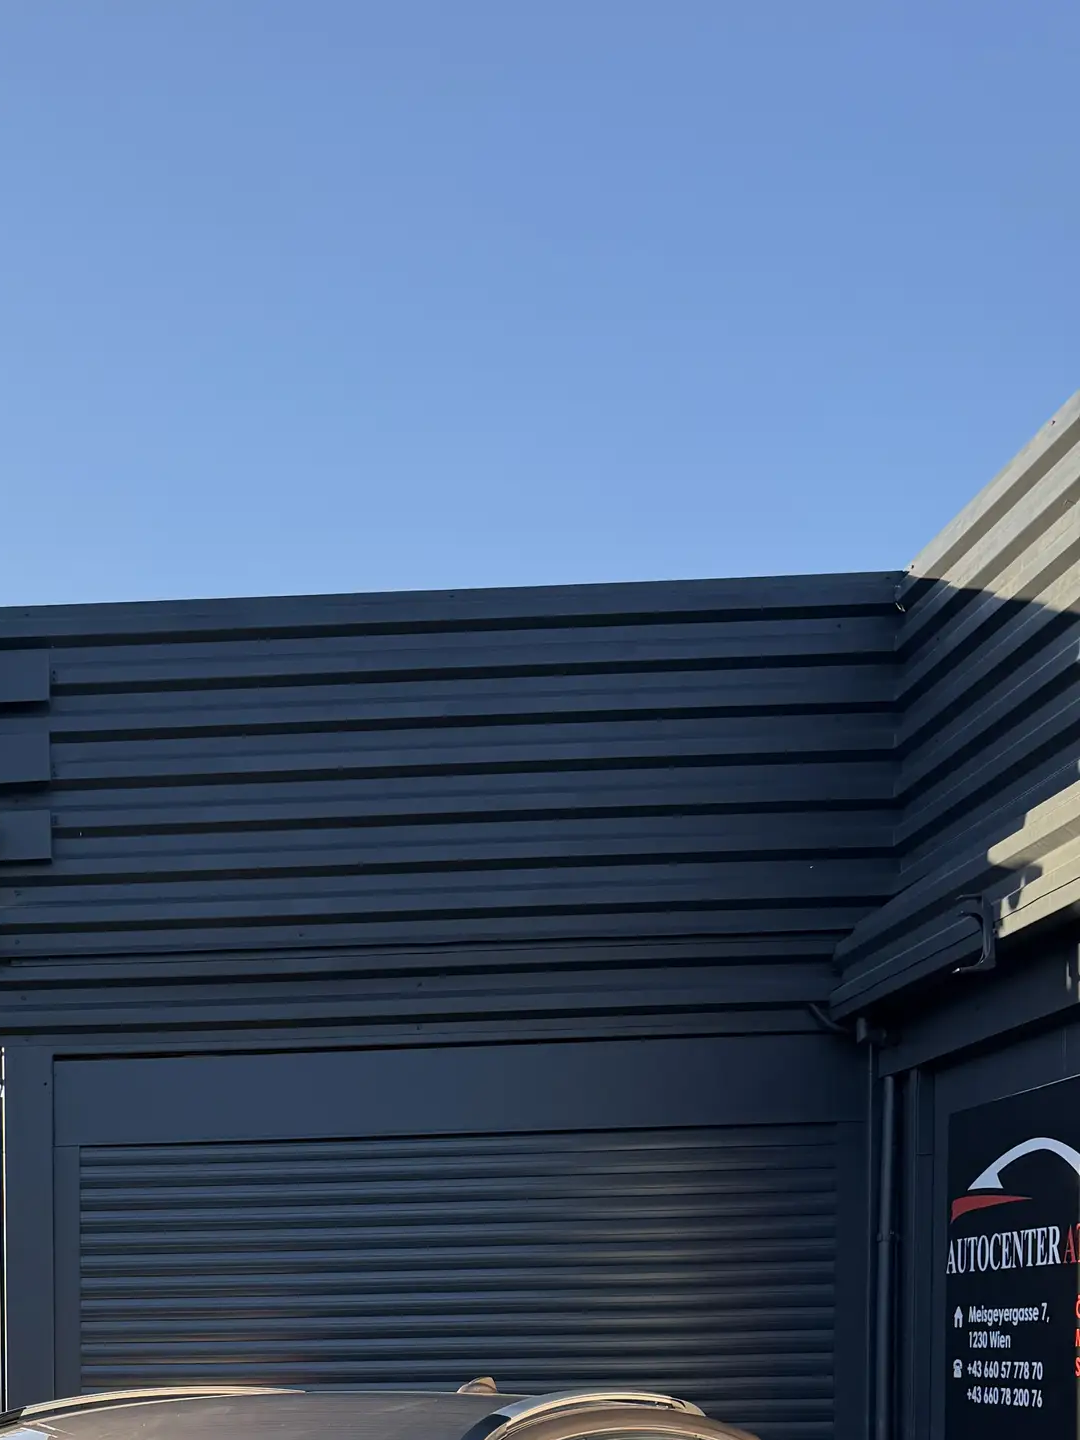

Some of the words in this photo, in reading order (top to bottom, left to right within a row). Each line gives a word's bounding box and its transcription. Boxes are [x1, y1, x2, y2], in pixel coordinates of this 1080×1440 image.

[946, 1225, 1062, 1275] AUTOCENTER
[968, 1305, 1039, 1326] Meisgeyergasse
[1041, 1302, 1050, 1323] 7,
[969, 1331, 988, 1349] 1230
[989, 1331, 1011, 1349] Wien
[967, 1360, 982, 1378] +43
[983, 1361, 999, 1378] 660
[1000, 1361, 1011, 1379] 57
[1013, 1361, 1029, 1380] 778
[1031, 1361, 1043, 1380] 70
[967, 1385, 982, 1403] +43
[983, 1386, 999, 1404] 660
[1000, 1387, 1011, 1406] 78
[1013, 1387, 1029, 1407] 200
[1031, 1389, 1043, 1408] 76
